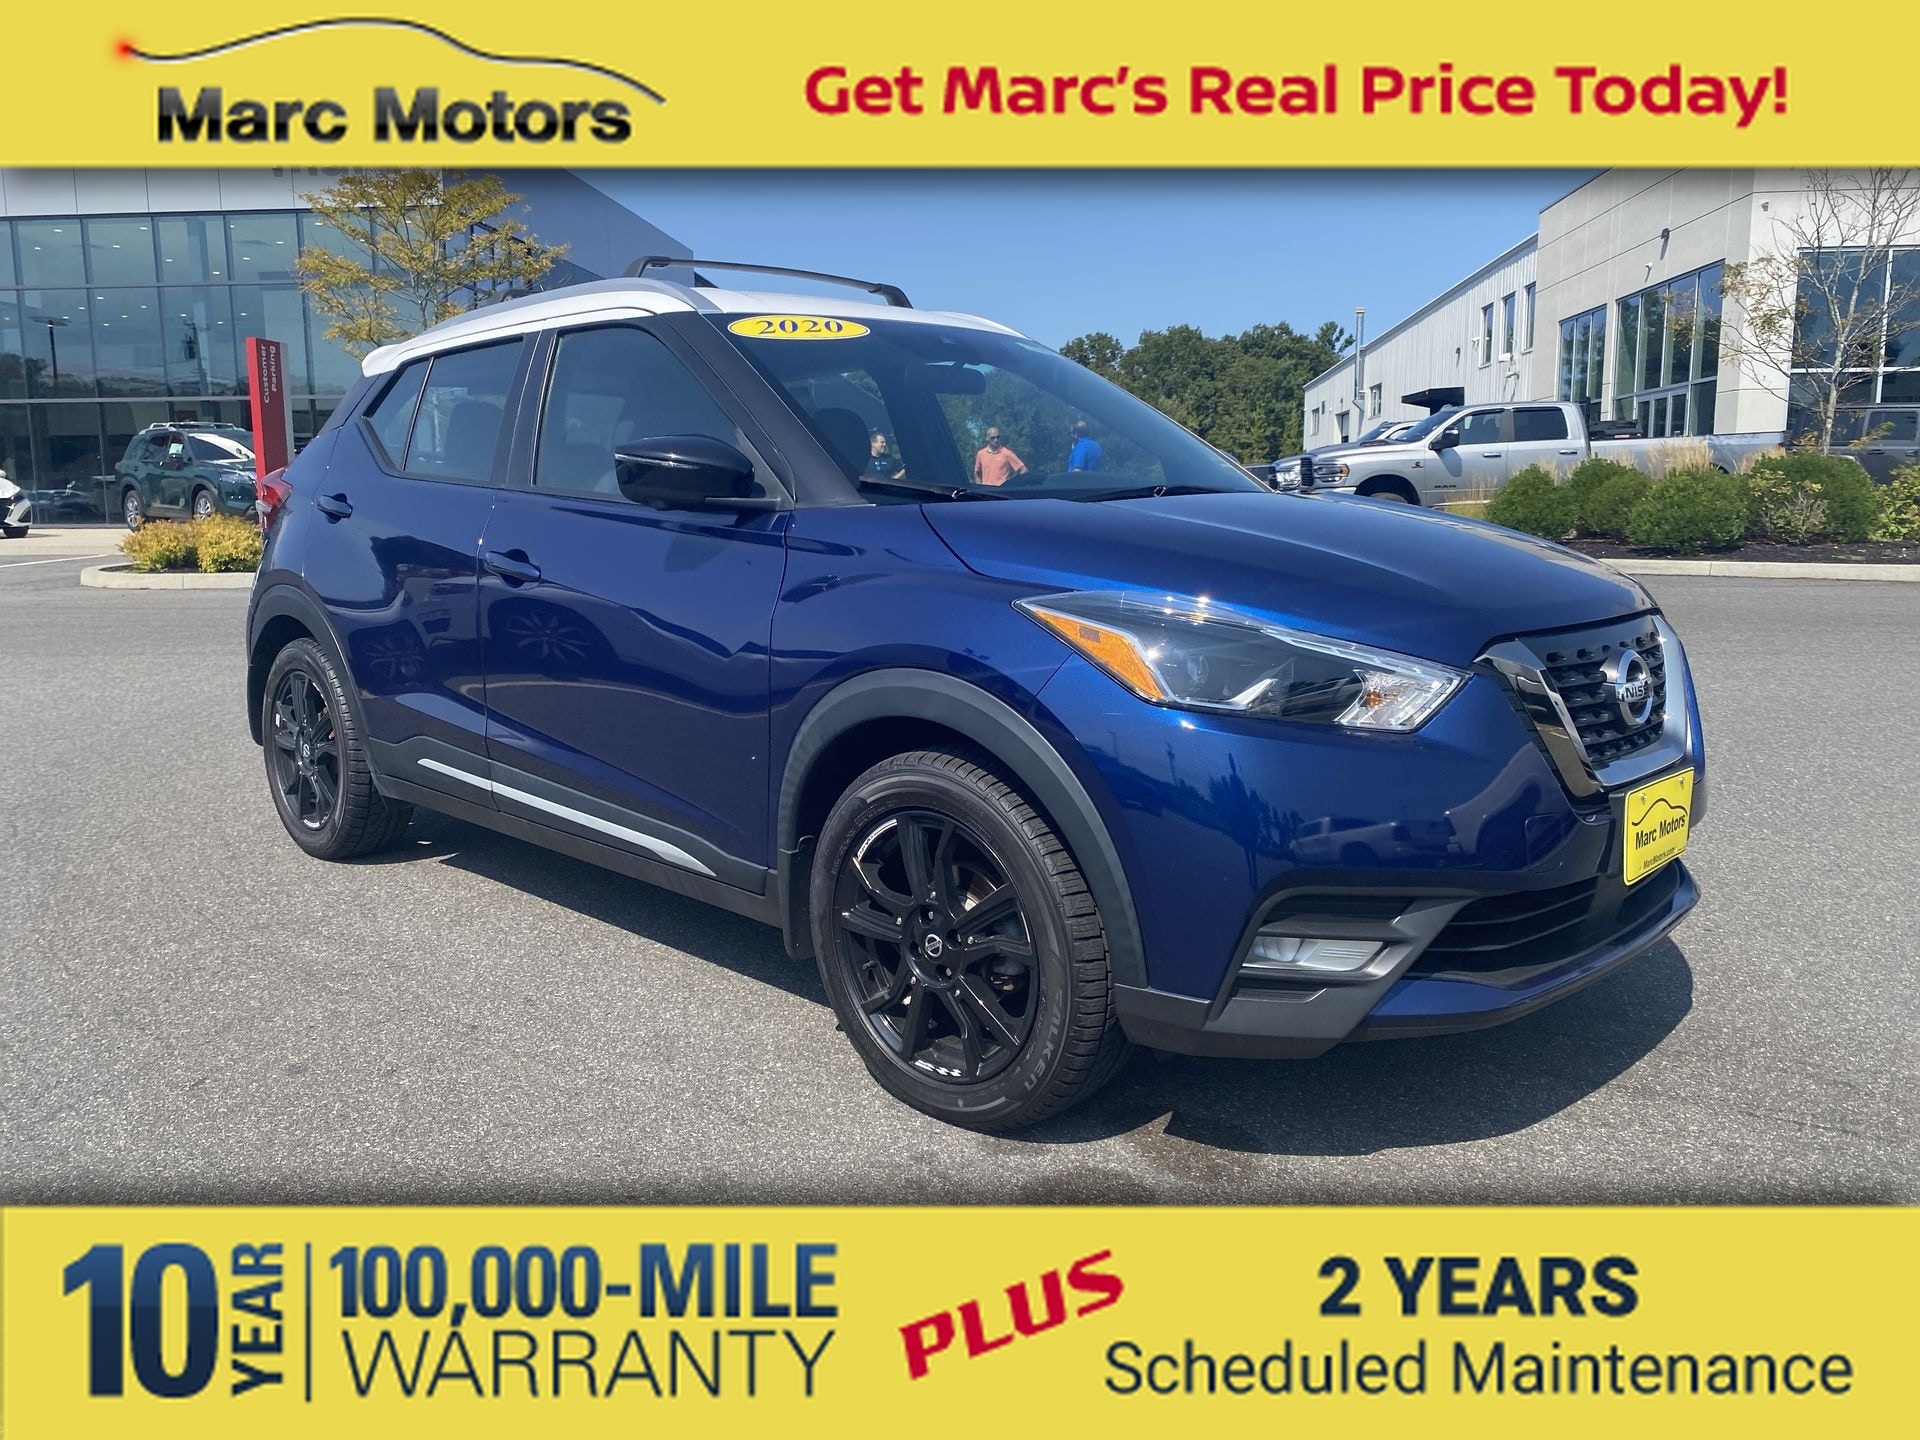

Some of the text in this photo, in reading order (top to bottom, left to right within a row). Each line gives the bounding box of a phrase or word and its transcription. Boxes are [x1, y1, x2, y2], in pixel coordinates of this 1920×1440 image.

[756, 319, 843, 334] 2020
[261, 344, 270, 403] Customer
[269, 345, 278, 392] Parking
[1635, 814, 1686, 850] Marc Motors
